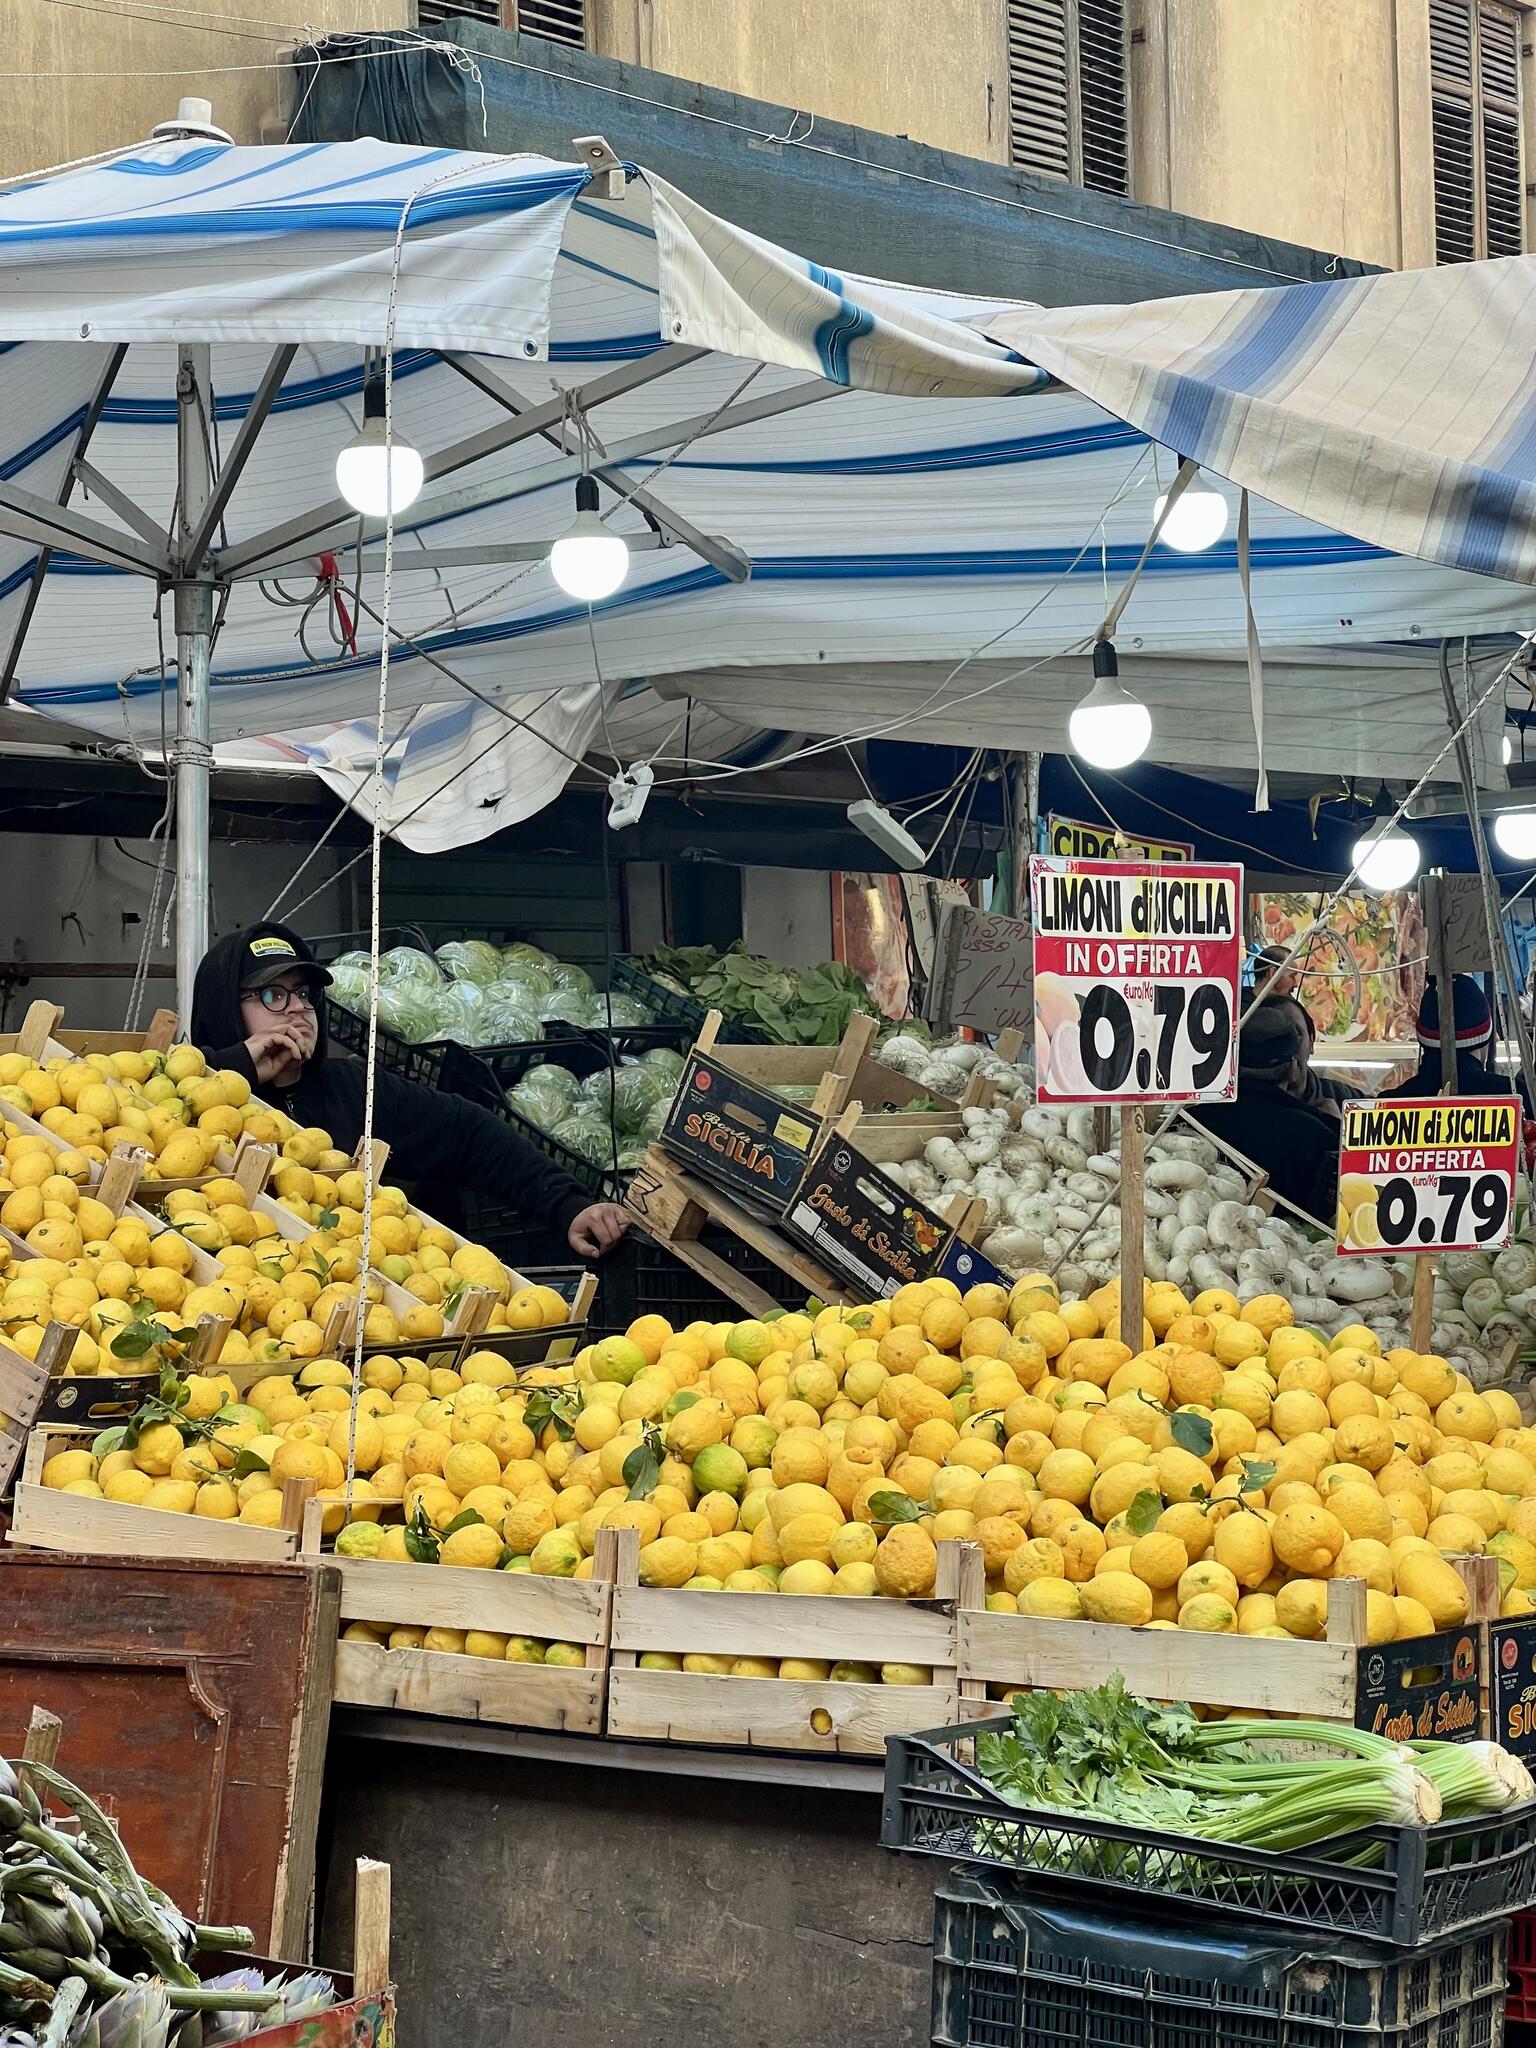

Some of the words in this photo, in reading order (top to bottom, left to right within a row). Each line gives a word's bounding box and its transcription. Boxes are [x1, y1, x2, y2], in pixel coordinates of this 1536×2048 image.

[1040, 876, 1123, 932] LIMONI
[1131, 879, 1153, 933] di
[1154, 880, 1231, 935] SICILIA
[1066, 942, 1090, 974] IN
[1080, 983, 1230, 1091] 0.79
[684, 1113, 775, 1180] SICILIA
[1349, 1111, 1420, 1147] LIMONI
[1424, 1110, 1441, 1144] di
[1445, 1108, 1511, 1144] SICILIA
[1368, 1151, 1390, 1172] IN
[1395, 1149, 1486, 1172] OFFERTA
[806, 1183, 852, 1227] Gusto
[851, 1218, 872, 1242] di
[867, 1231, 917, 1281] Sicilia
[1376, 1174, 1508, 1246] 0.79
[1417, 1699, 1433, 1738] di
[1435, 1688, 1475, 1734] Sicilia
